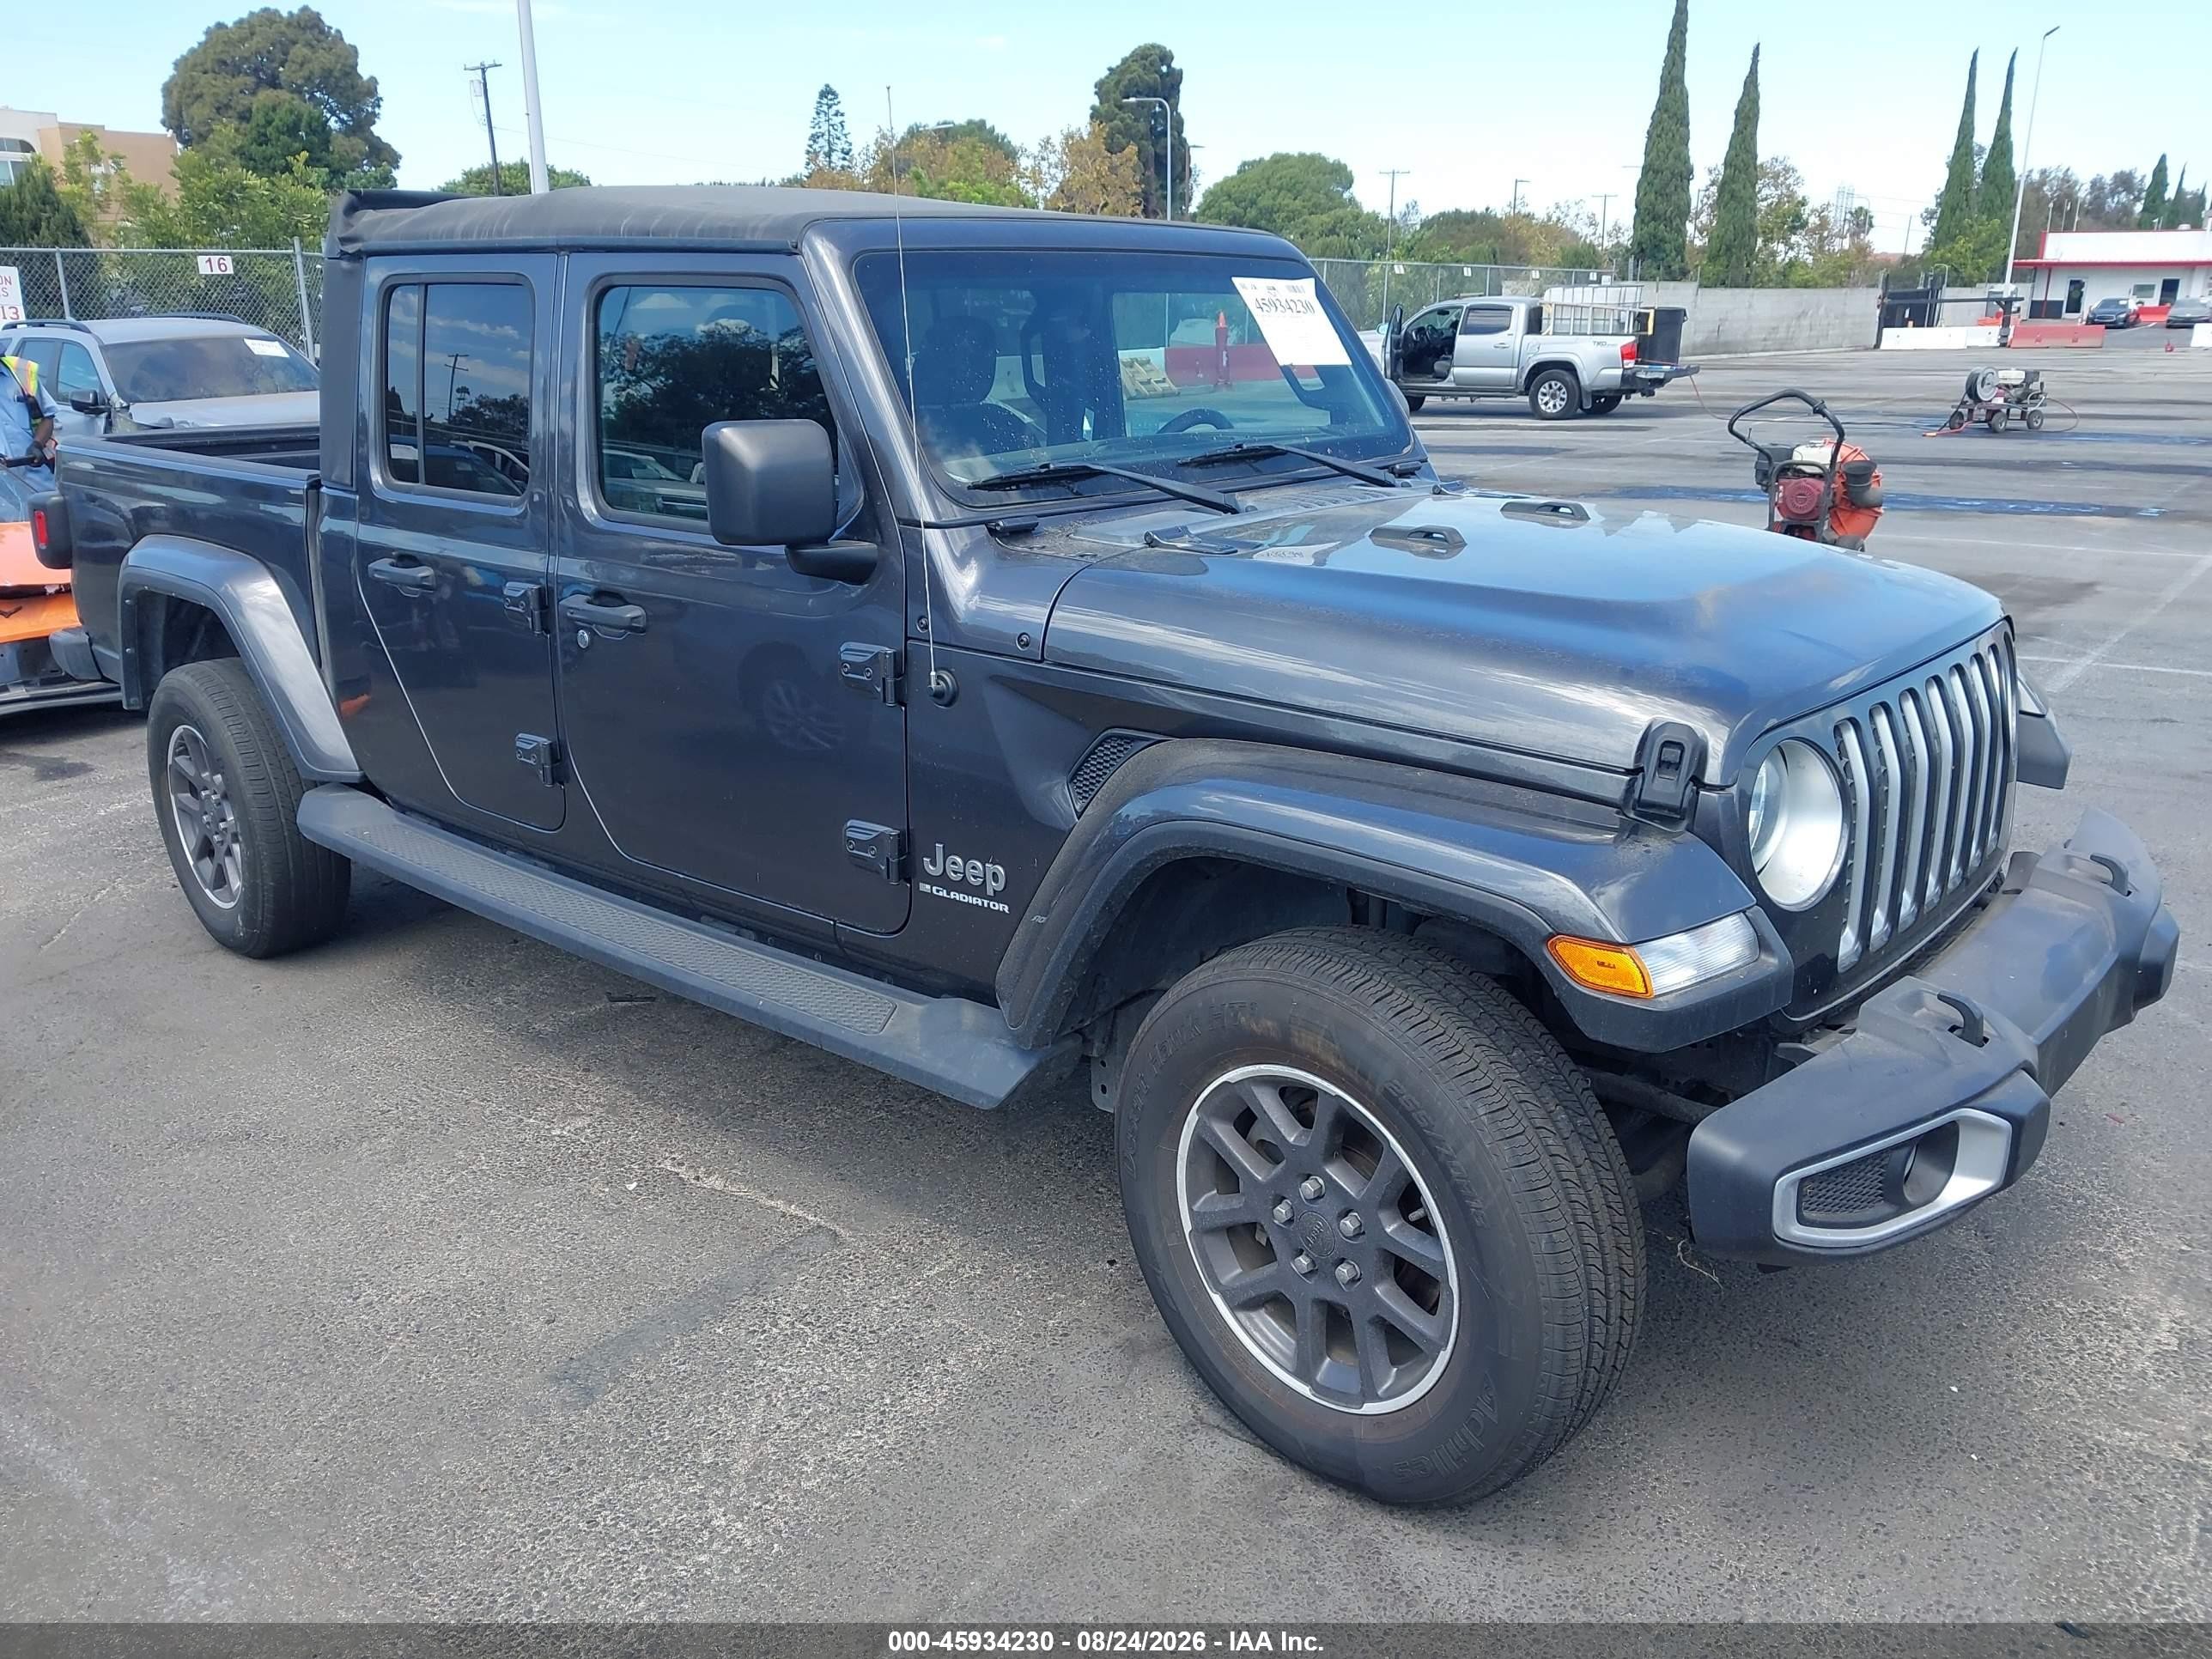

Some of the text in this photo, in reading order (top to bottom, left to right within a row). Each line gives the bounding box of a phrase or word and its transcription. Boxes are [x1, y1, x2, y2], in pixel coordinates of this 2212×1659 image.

[205, 257, 228, 273] 16
[1255, 297, 1316, 314] 45934230
[922, 842, 1006, 896] Jeep
[932, 885, 1010, 914] GLADIATOR
[1393, 1370, 1498, 1485] Achilles
